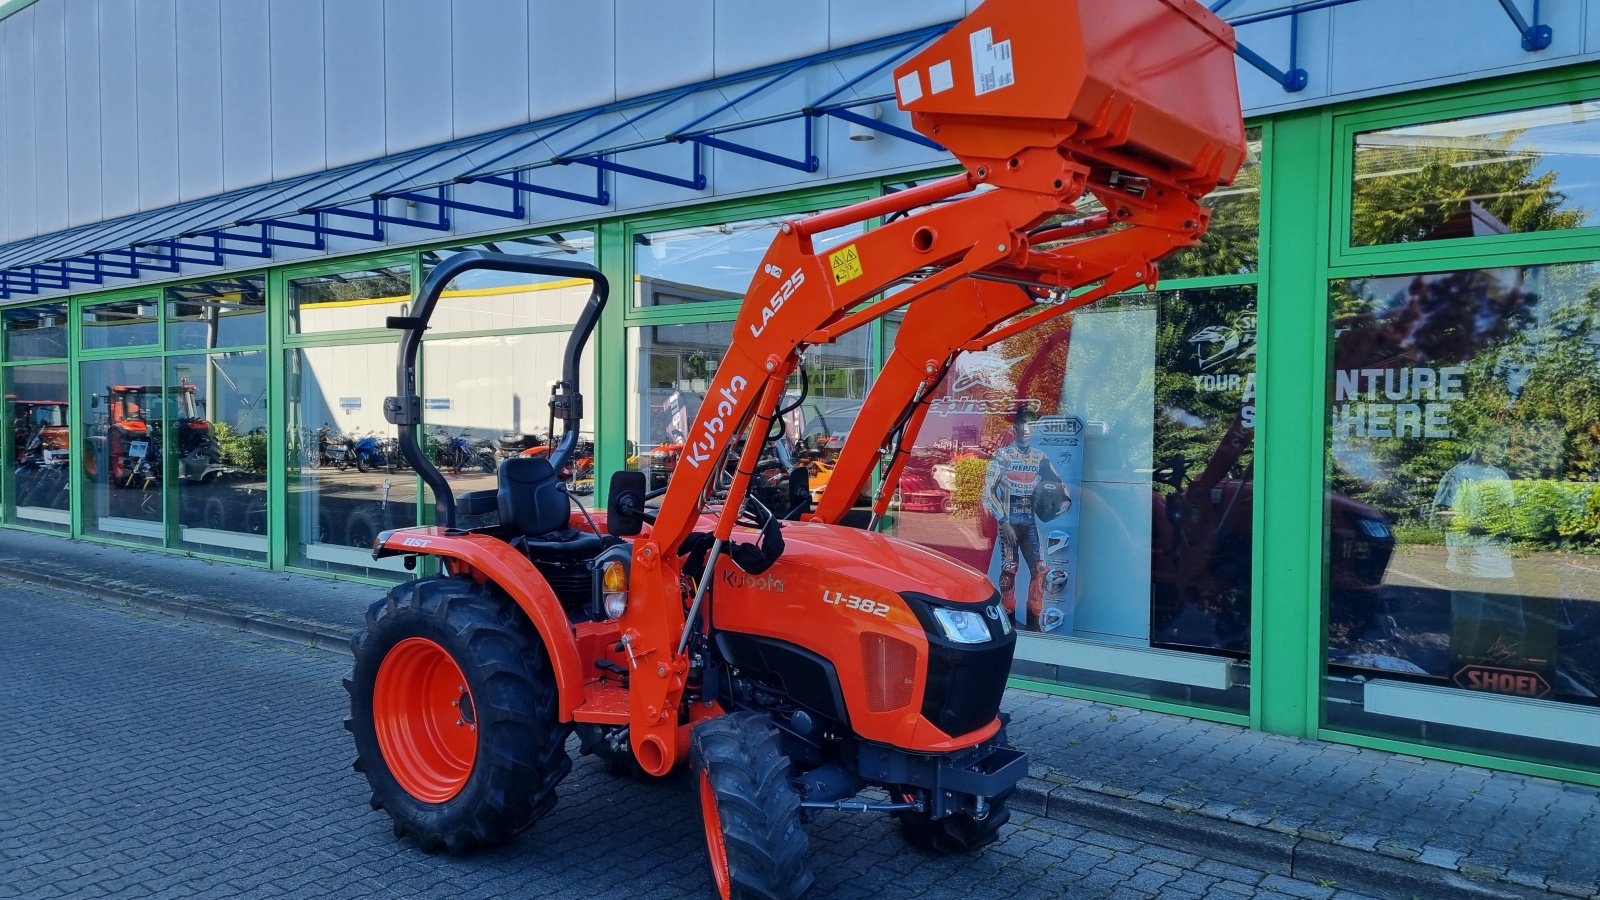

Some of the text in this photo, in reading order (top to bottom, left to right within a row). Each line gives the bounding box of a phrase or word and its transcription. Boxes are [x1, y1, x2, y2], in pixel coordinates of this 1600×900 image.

[750, 267, 805, 337] LA525
[1193, 374, 1240, 393] YOUR
[685, 375, 748, 468] Kubota
[402, 537, 432, 548] HST
[722, 569, 785, 593] Kubota
[822, 590, 891, 618] L1-382
[1467, 670, 1537, 696] SHOEI
